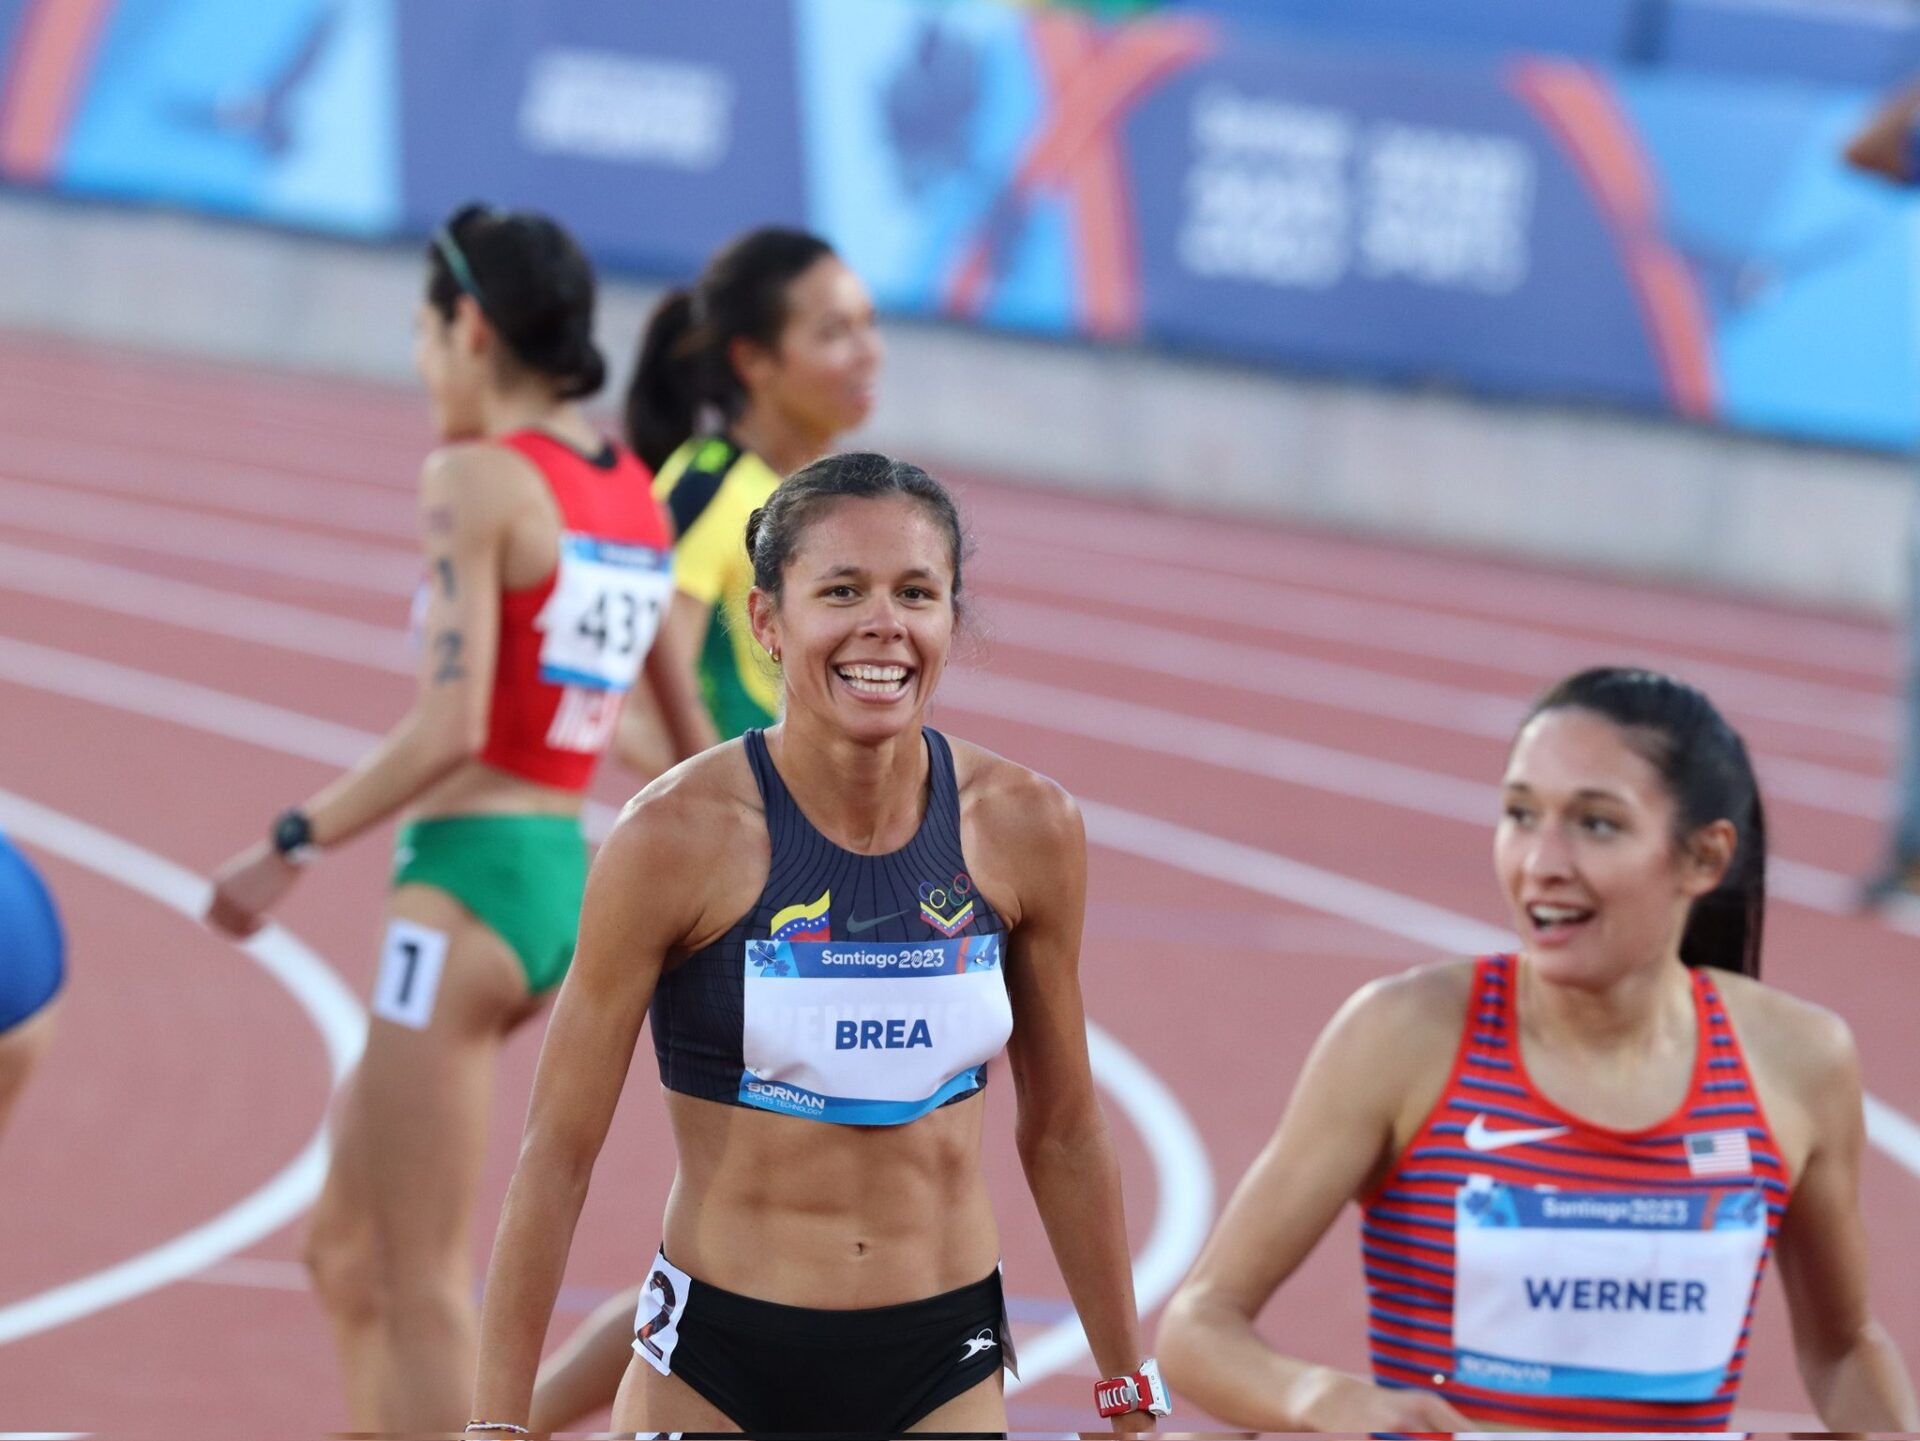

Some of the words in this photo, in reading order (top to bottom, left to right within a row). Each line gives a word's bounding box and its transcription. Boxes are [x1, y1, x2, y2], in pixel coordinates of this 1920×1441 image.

[397, 942, 421, 1005] 1
[821, 949, 898, 968] Santiago
[898, 948, 945, 969] 2023
[835, 1018, 933, 1050] BREA
[744, 1082, 825, 1110] BORNAN
[775, 1098, 824, 1116] TECHNOLOGY
[1524, 1277, 1707, 1313] WERNER
[637, 1270, 676, 1361] 2
